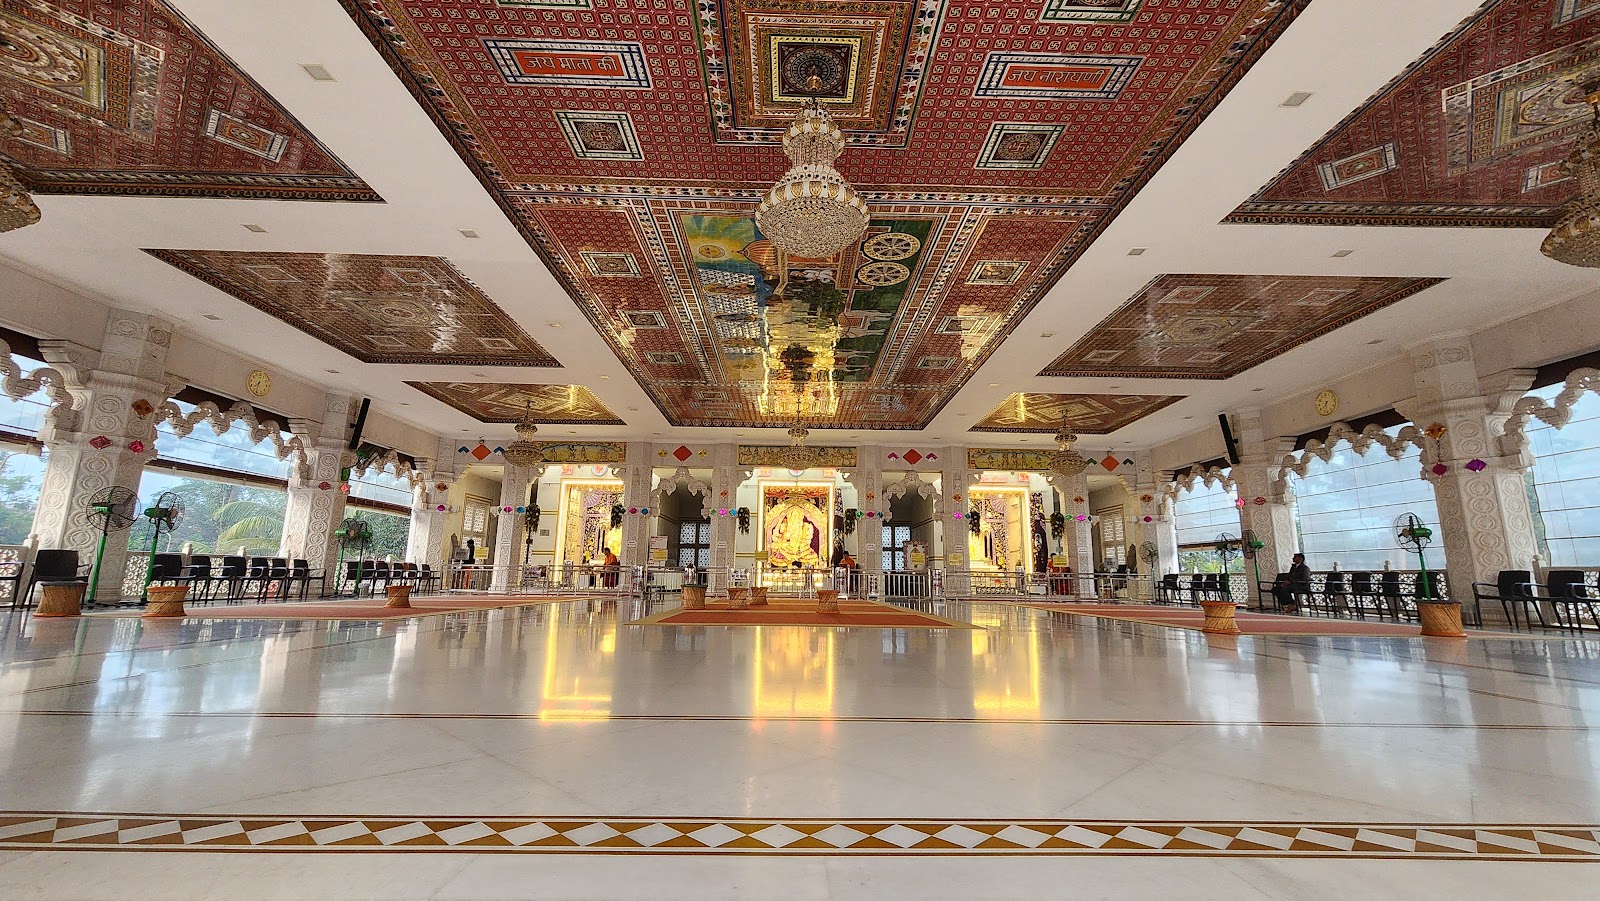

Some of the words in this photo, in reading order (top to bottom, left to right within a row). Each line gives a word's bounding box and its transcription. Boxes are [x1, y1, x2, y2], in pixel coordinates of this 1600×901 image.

[523, 56, 555, 69] जय
[556, 57, 593, 71] माता
[594, 55, 618, 72] की
[1007, 69, 1038, 82] जय
[1039, 69, 1106, 84] नारायणी
